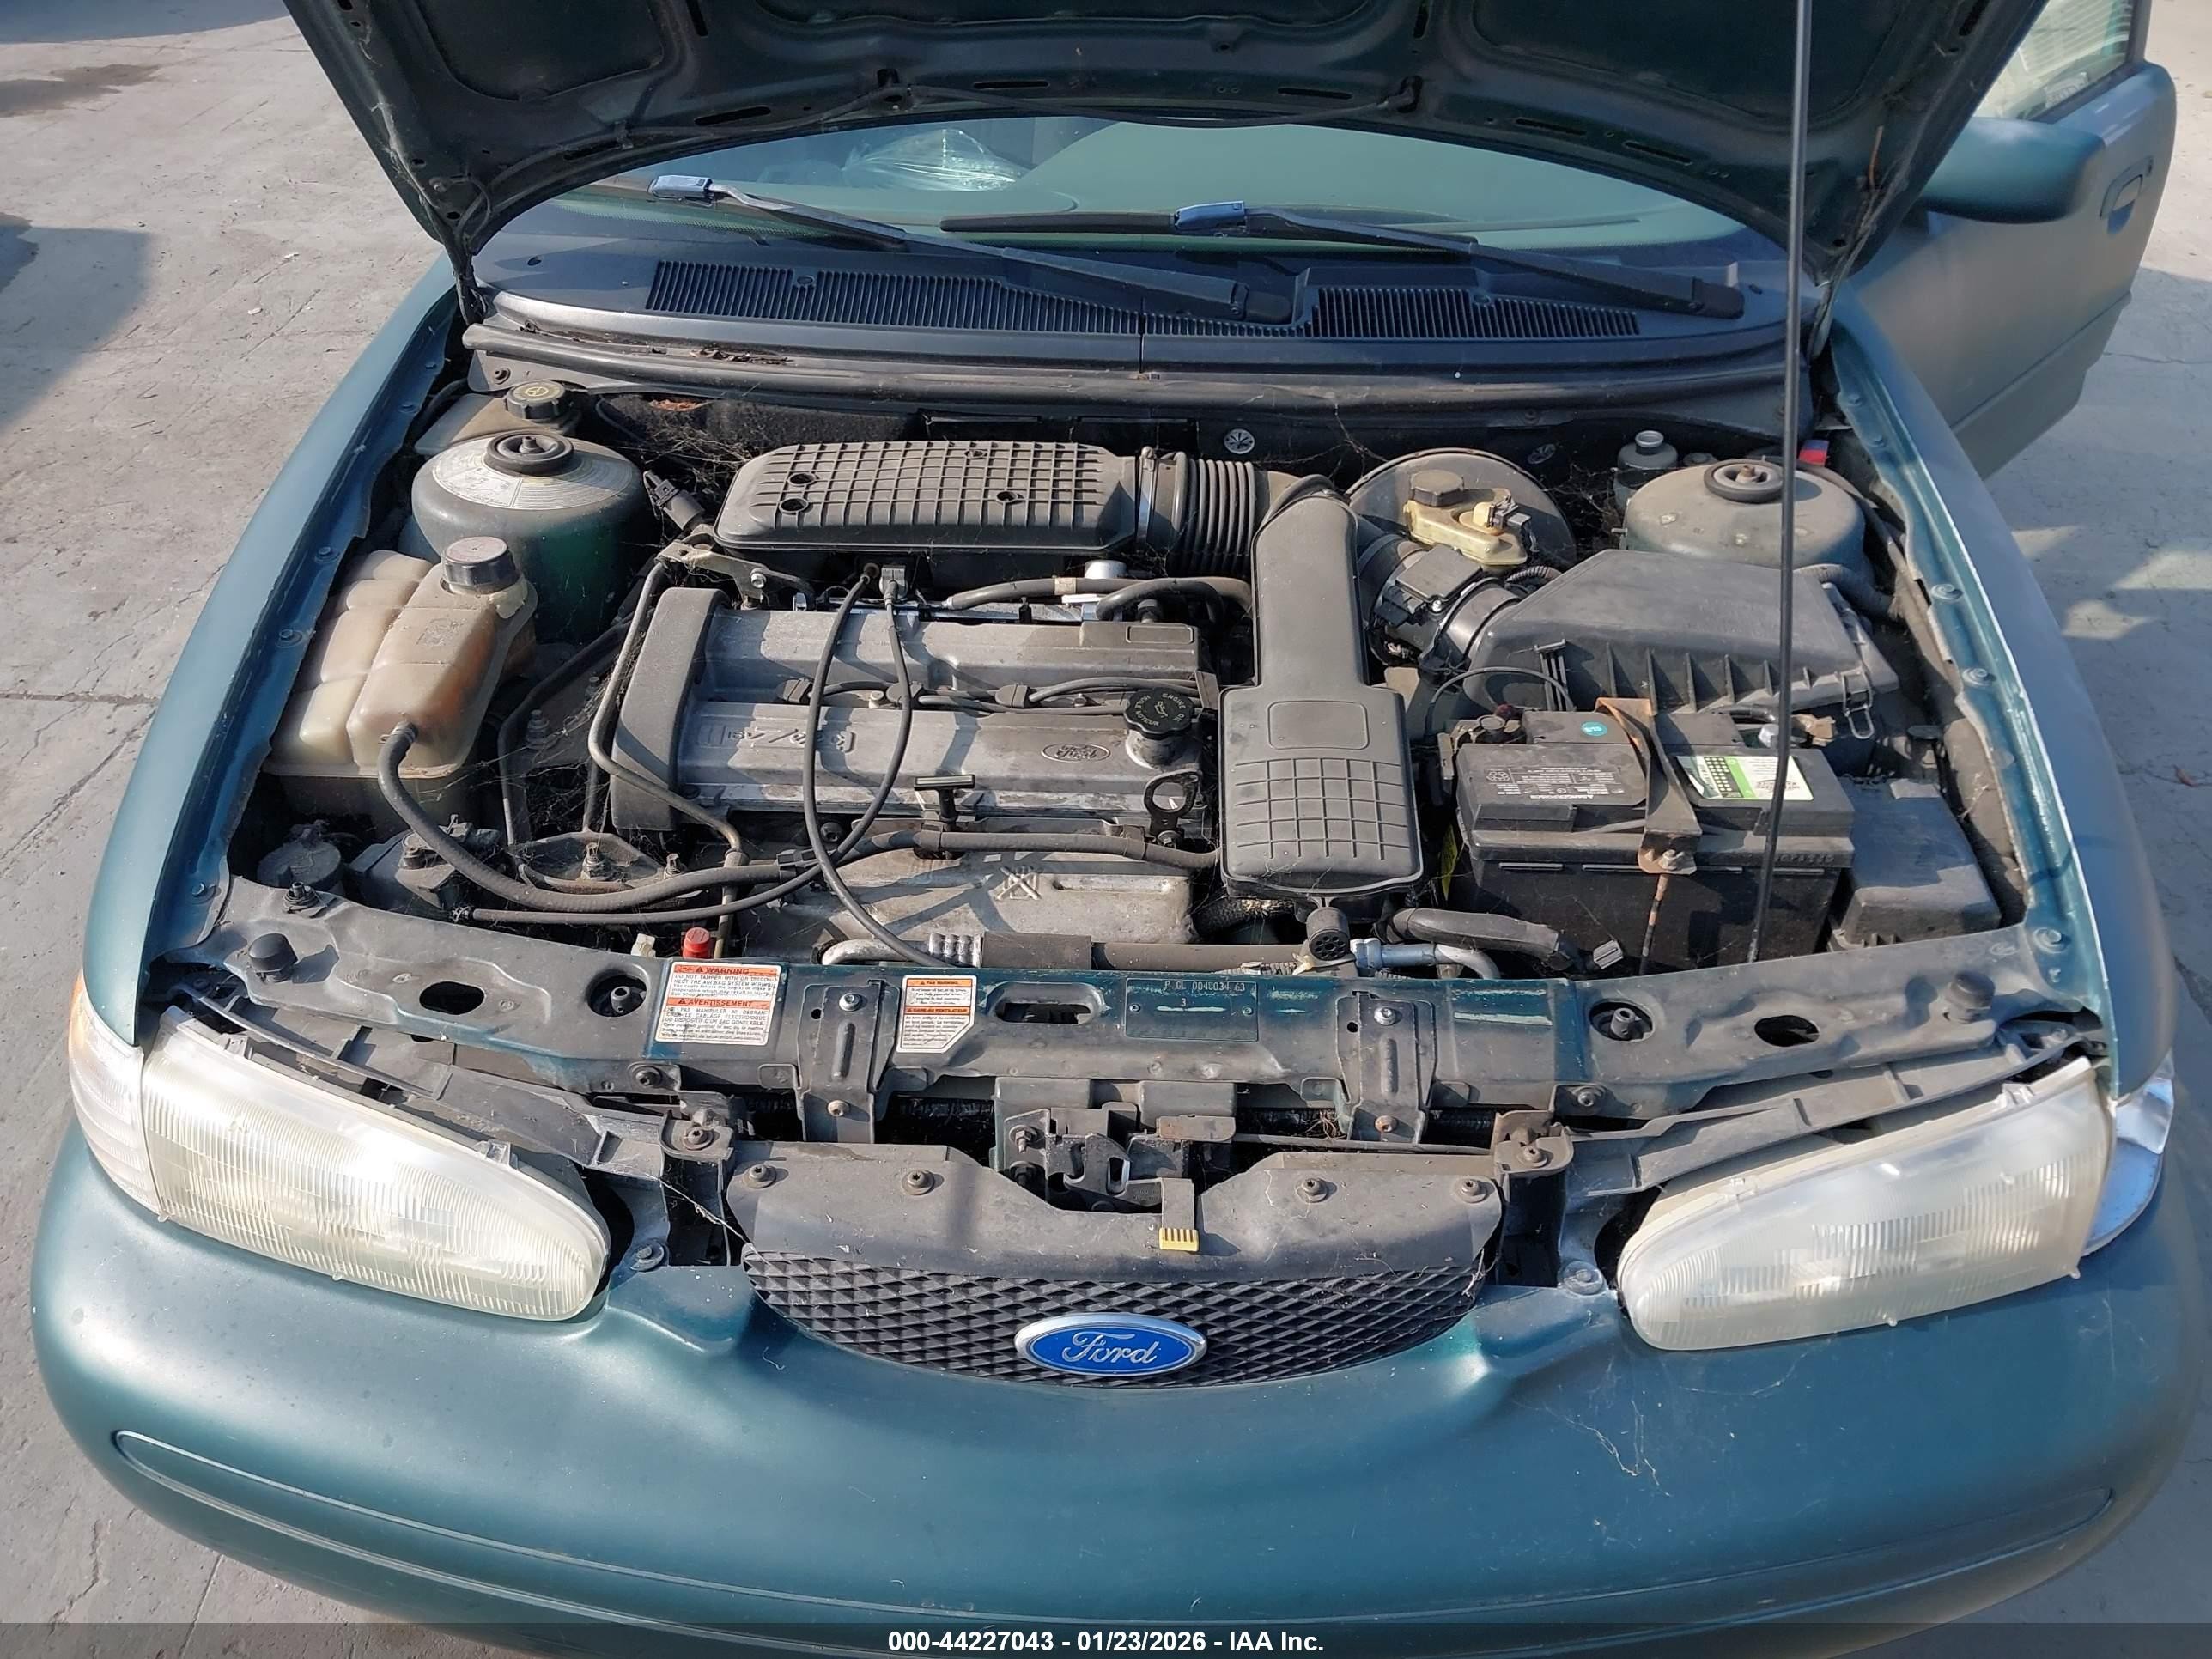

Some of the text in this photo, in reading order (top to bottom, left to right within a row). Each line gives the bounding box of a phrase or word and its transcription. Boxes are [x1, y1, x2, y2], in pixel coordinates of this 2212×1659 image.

[1135, 695, 1159, 726] HUILE MOTEUR
[1162, 693, 1186, 722] ENGINE OIL
[1055, 744, 1097, 759] Ford
[706, 966, 750, 975] WARNING
[688, 998, 753, 1007] AVERTISSEMENT
[1181, 997, 1187, 1007] 3
[1061, 1331, 1159, 1364] Ford
